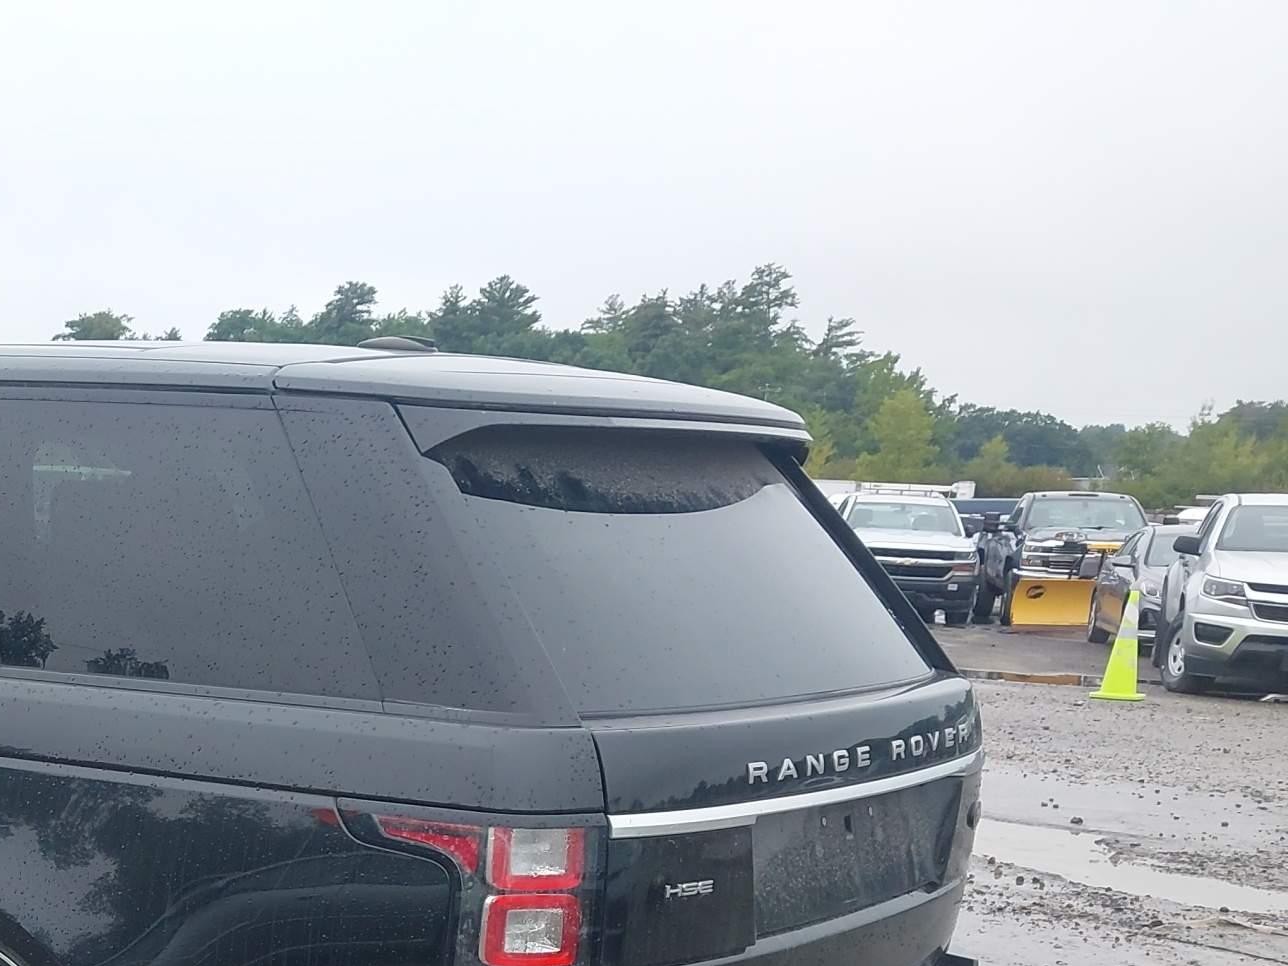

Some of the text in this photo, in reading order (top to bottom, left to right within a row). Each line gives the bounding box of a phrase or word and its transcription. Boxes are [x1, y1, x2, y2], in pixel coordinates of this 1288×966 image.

[747, 724, 970, 784] RANGE ROVER
[665, 879, 714, 898] HSE
